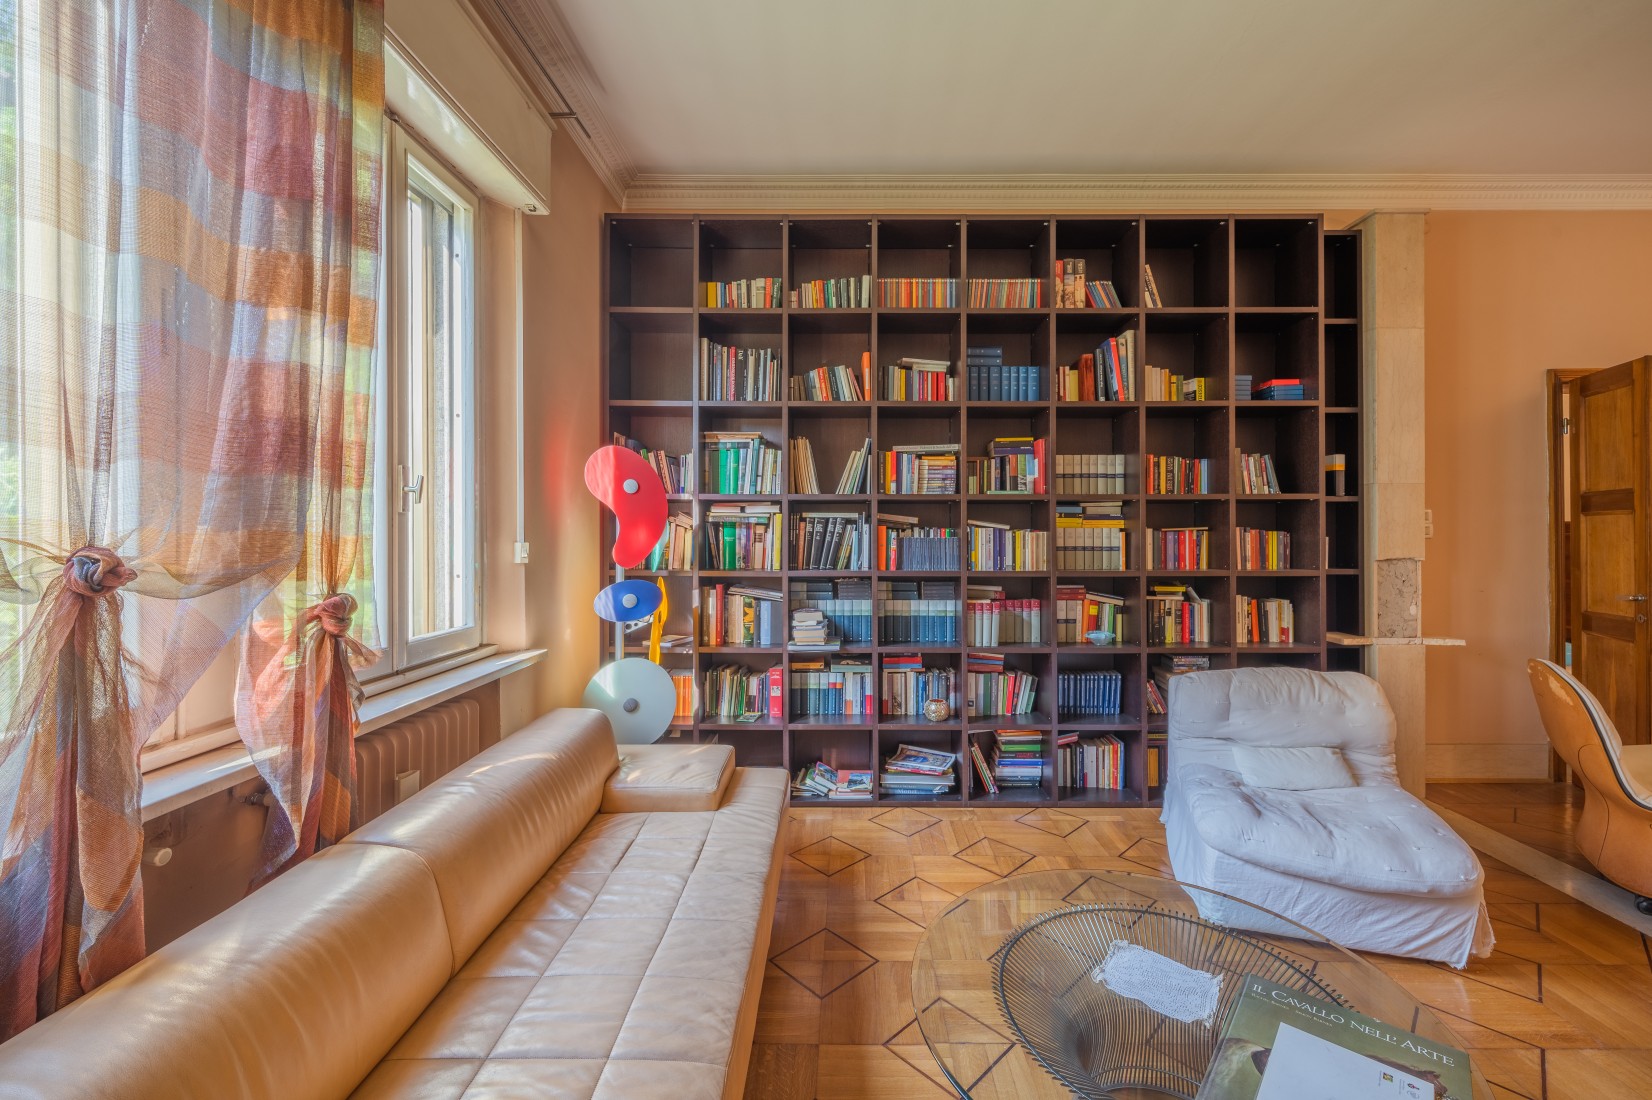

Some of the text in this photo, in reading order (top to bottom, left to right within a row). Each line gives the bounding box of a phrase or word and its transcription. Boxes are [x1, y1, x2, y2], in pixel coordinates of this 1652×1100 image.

[1252, 984, 1266, 995] IL
[1272, 990, 1345, 1024] CAVALLO
[1400, 1040, 1455, 1067] ARTE
